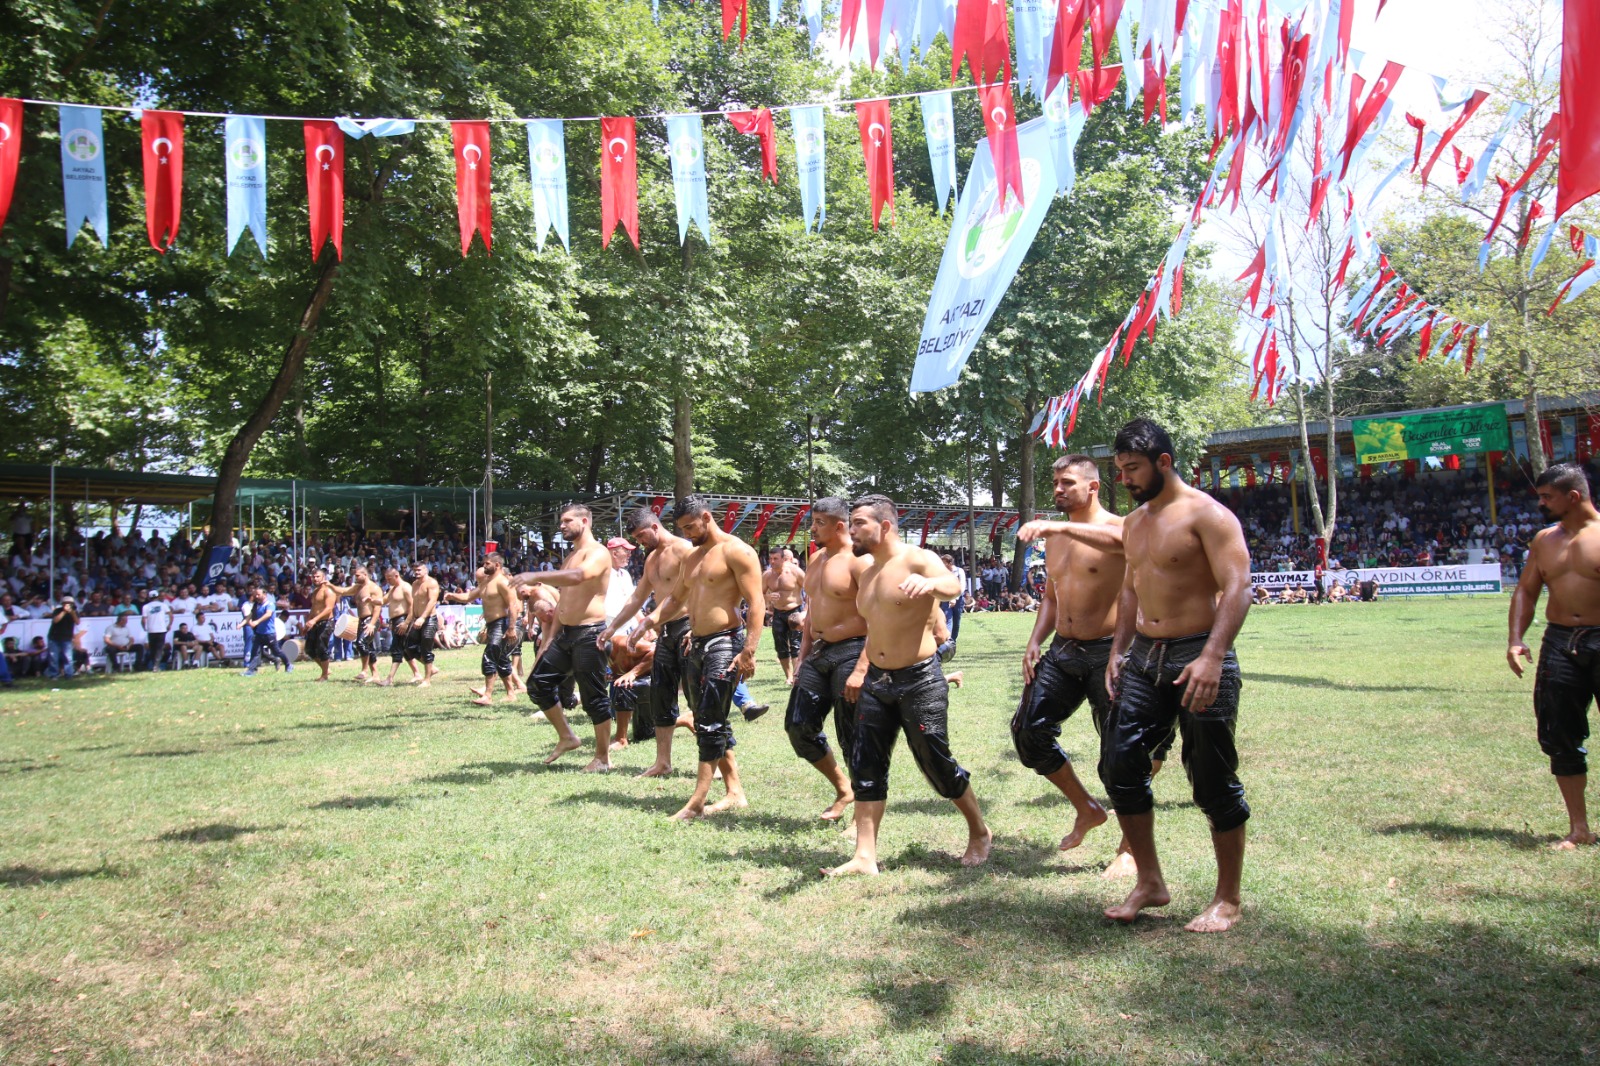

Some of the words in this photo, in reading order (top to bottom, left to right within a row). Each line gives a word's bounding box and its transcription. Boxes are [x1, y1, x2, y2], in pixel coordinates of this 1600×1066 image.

[1371, 570, 1416, 582] AYDIN
[1421, 568, 1466, 581] ÖRME
[1416, 584, 1461, 593] BAŞARILAR
[1462, 583, 1494, 591] DİLERİZ
